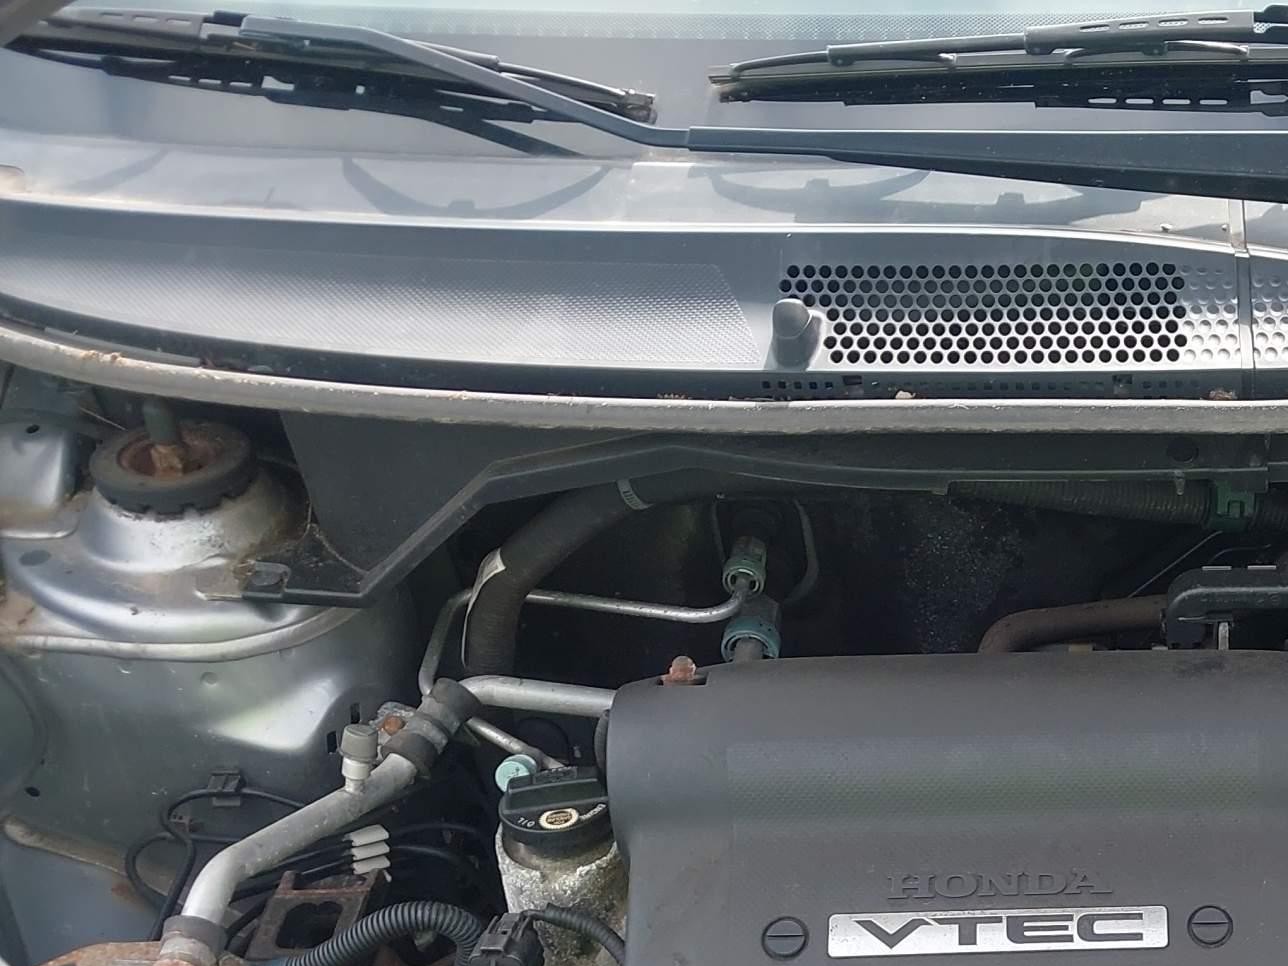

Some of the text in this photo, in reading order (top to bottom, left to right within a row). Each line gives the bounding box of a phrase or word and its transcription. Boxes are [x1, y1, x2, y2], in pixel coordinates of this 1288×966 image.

[517, 816, 536, 827] OIL
[888, 872, 1113, 899] HONDA
[854, 912, 1144, 949] VTEC
